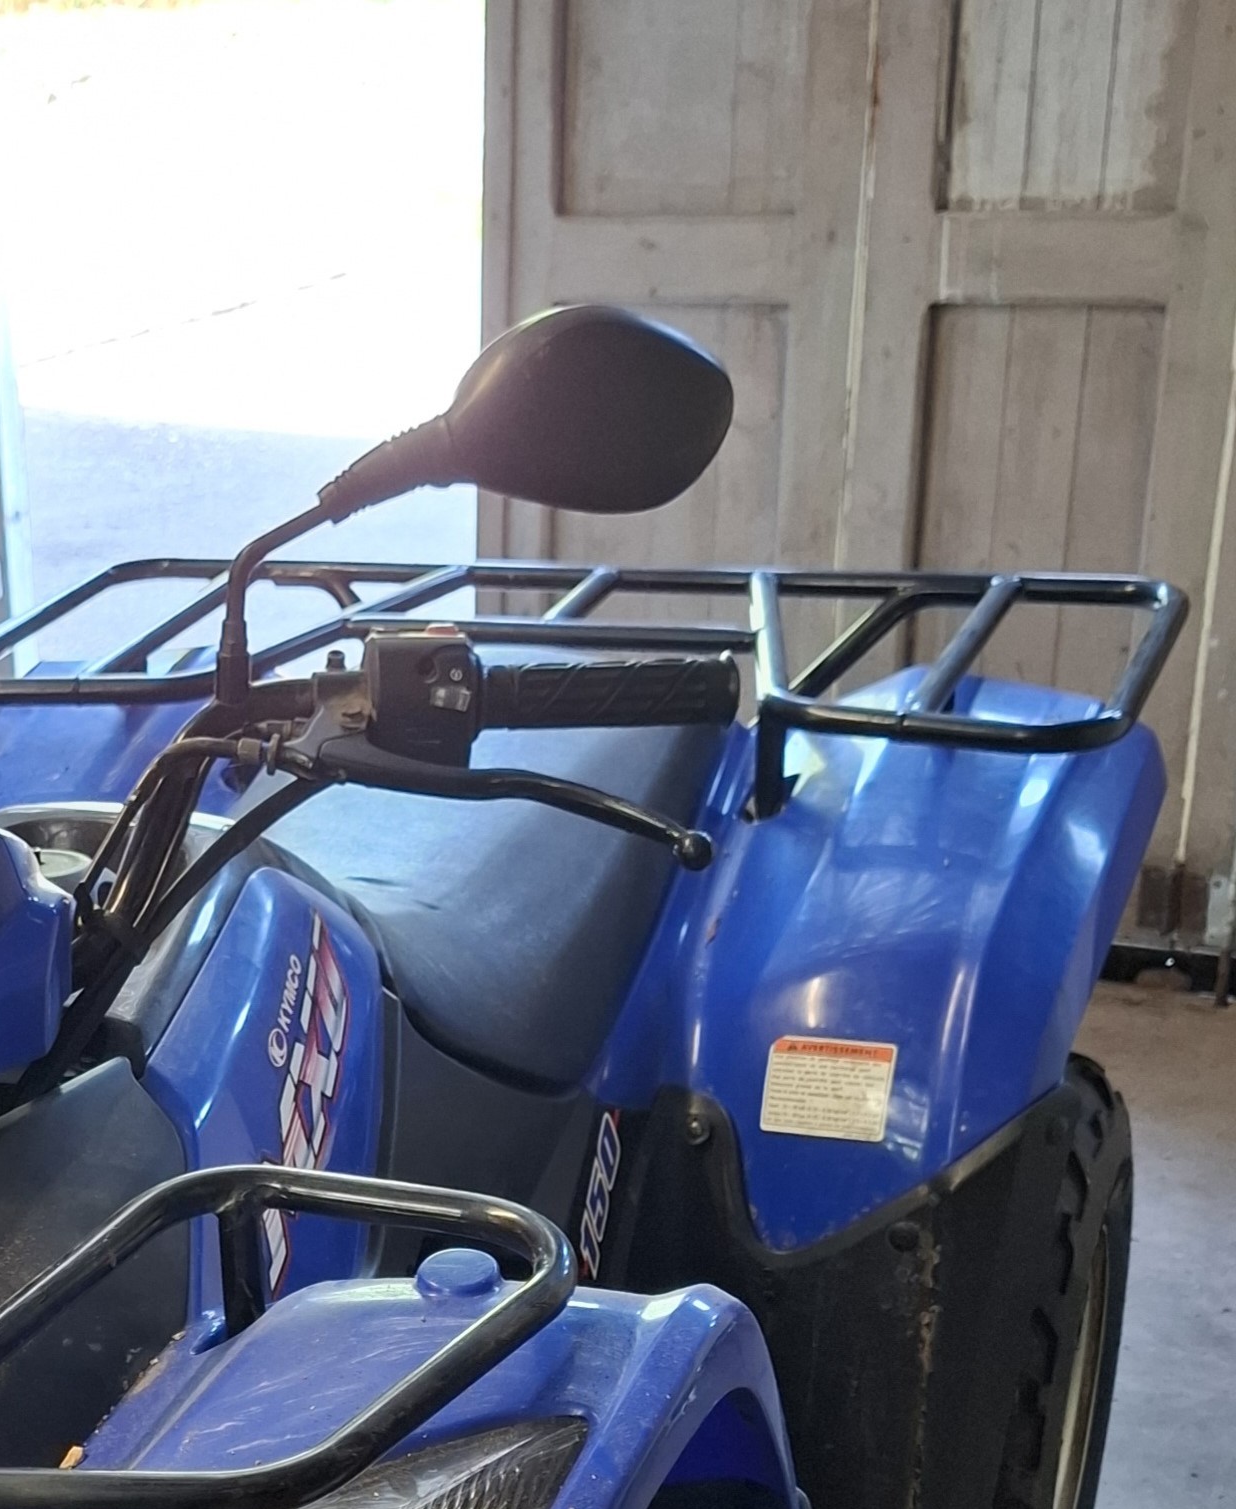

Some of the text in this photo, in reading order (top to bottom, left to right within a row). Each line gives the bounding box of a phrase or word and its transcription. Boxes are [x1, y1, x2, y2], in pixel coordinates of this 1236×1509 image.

[277, 953, 302, 1033] KYMCO
[800, 1043, 878, 1057] AVERTISSEMENT
[580, 1111, 622, 1281] 150
